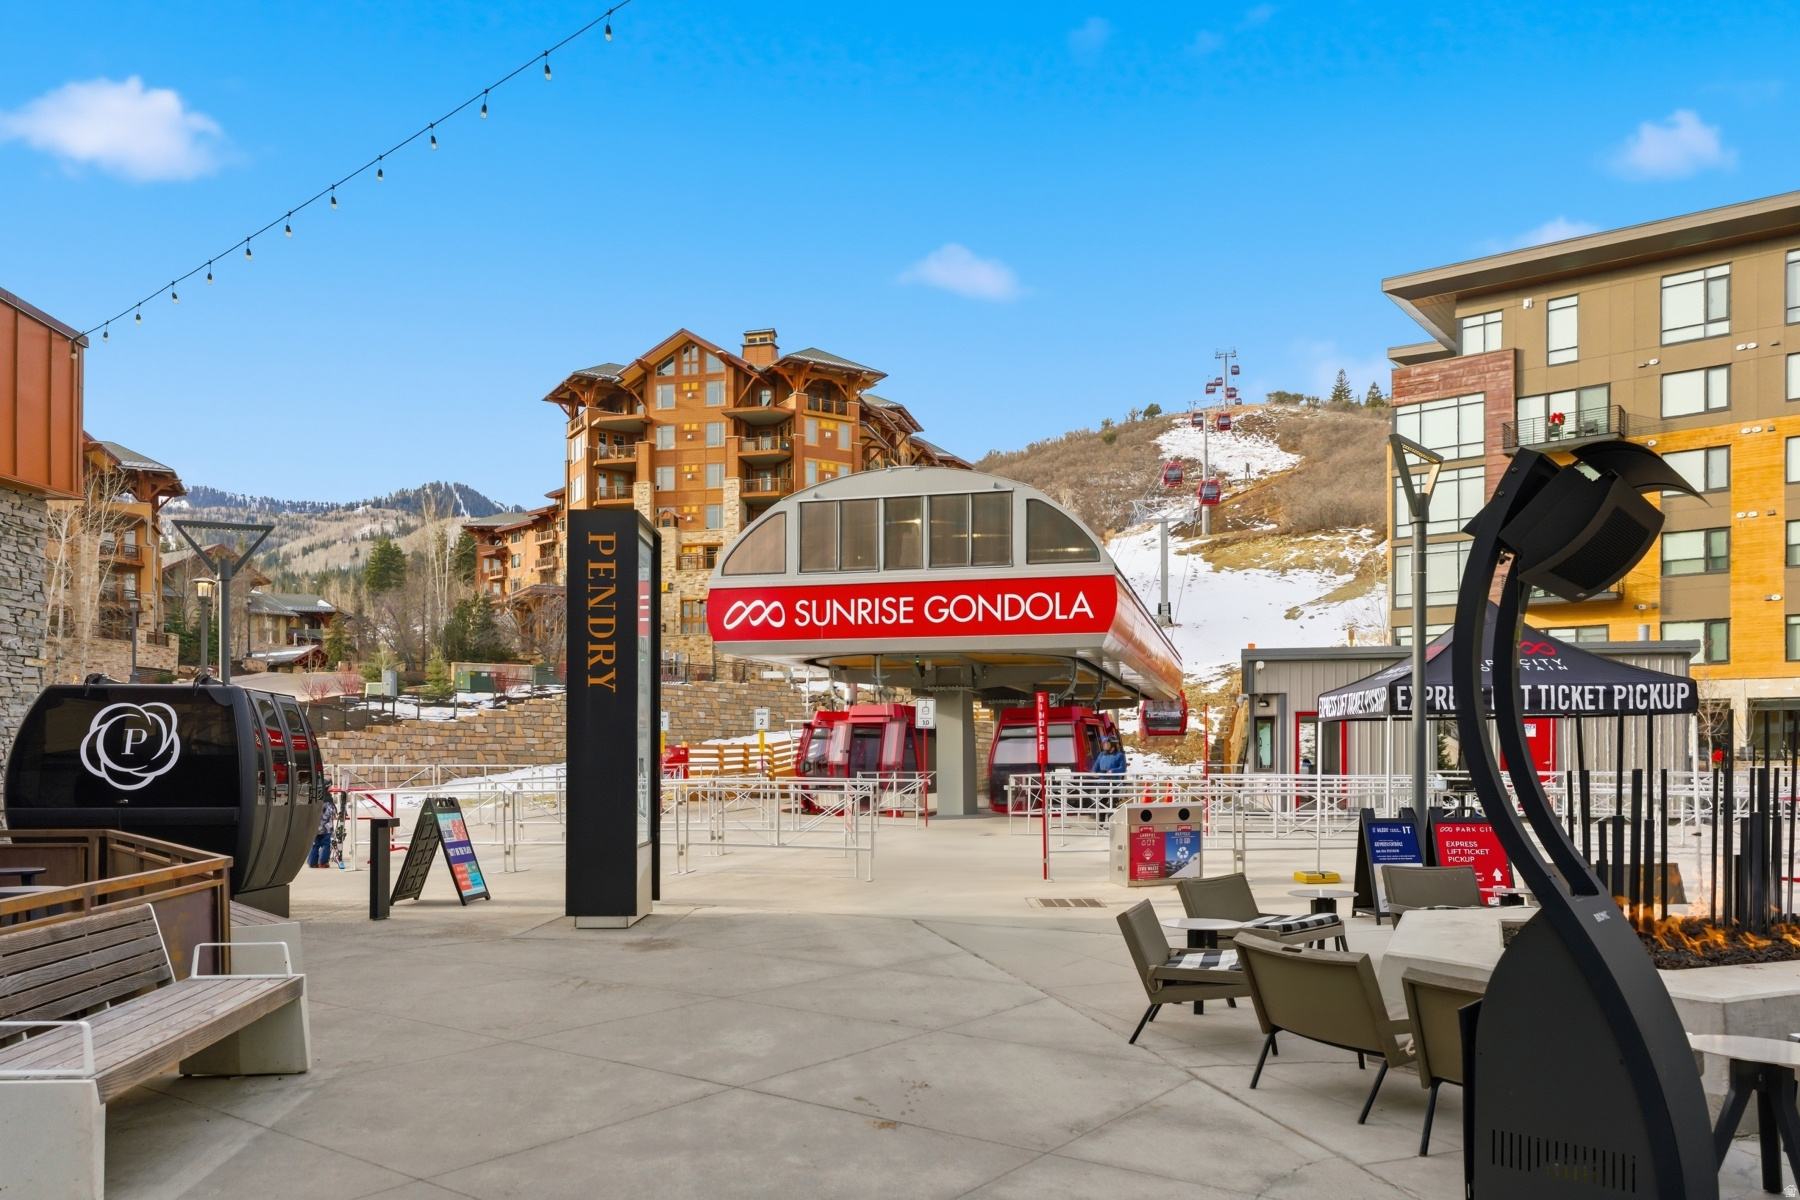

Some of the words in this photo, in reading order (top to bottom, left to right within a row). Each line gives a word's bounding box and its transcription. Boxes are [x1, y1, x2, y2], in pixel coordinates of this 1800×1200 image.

[587, 531, 617, 693] PENDRY
[794, 596, 915, 627] SUNRISE
[923, 591, 1095, 624] GONDOLA
[1537, 684, 1607, 711] TICKET
[1613, 682, 1690, 711] PICKUP
[759, 718, 765, 726] 2
[121, 728, 148, 755] P
[1445, 840, 1478, 848] EXPRESS
